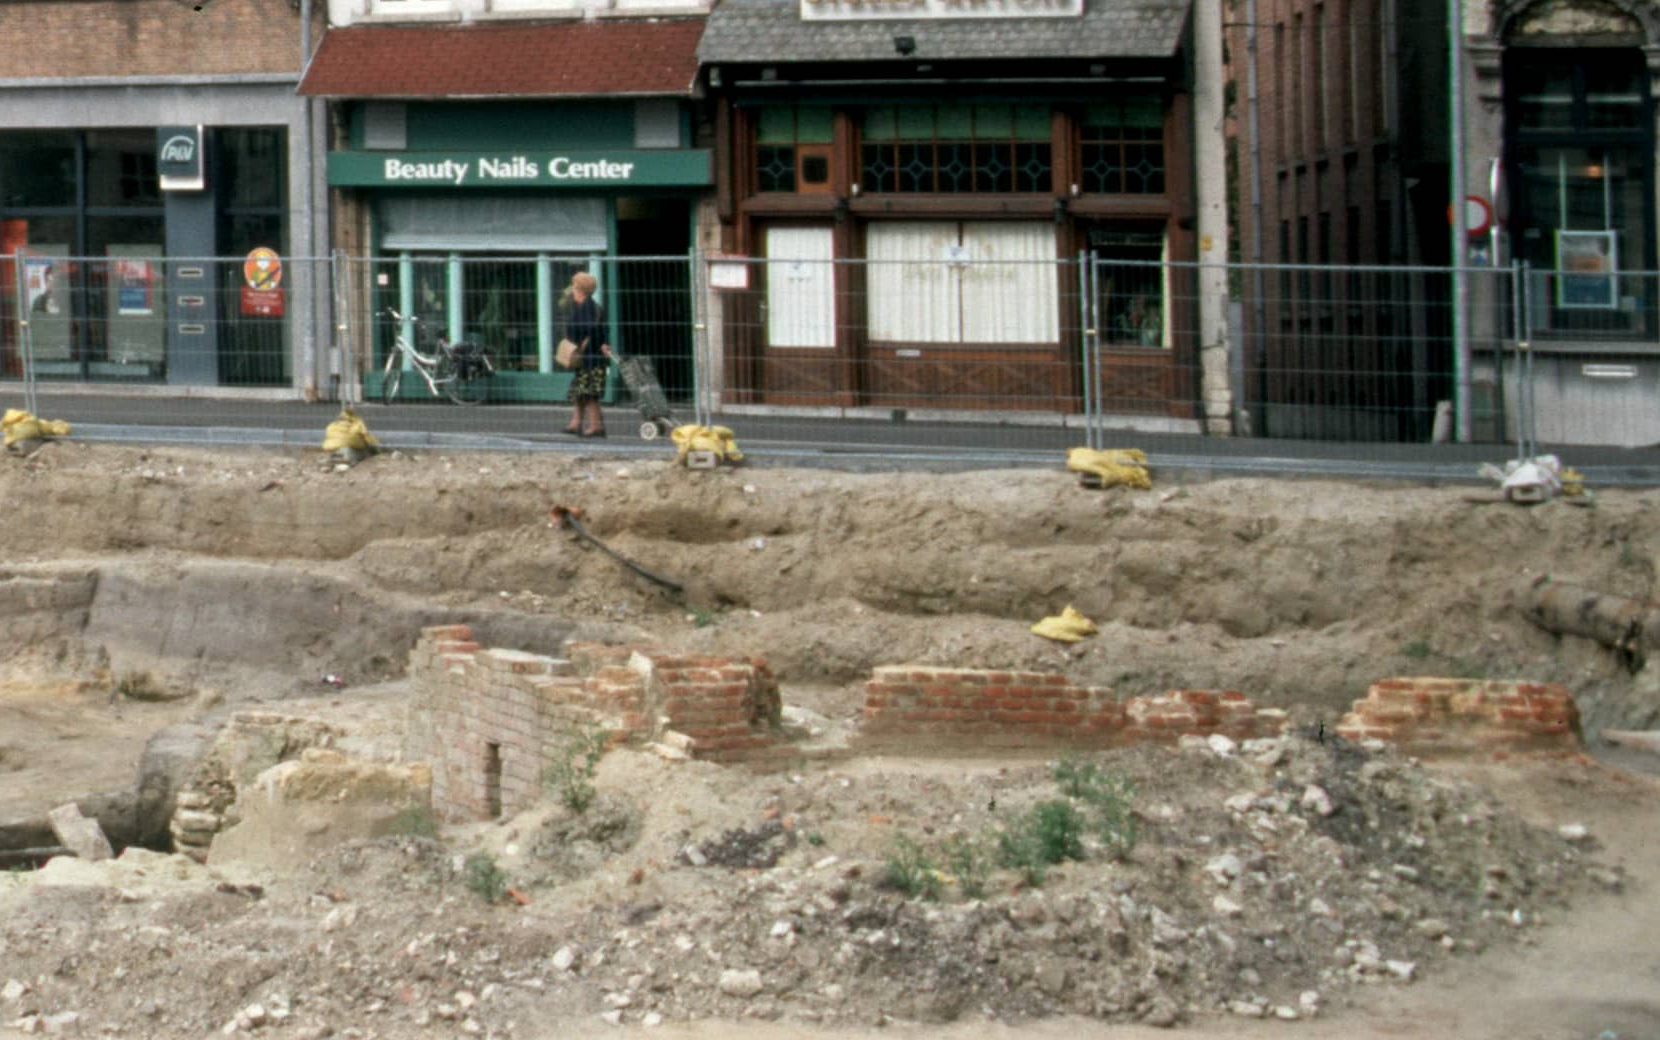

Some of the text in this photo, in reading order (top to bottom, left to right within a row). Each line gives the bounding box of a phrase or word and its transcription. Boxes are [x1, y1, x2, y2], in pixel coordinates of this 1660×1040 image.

[384, 157, 634, 185] Beauty Nails Center
